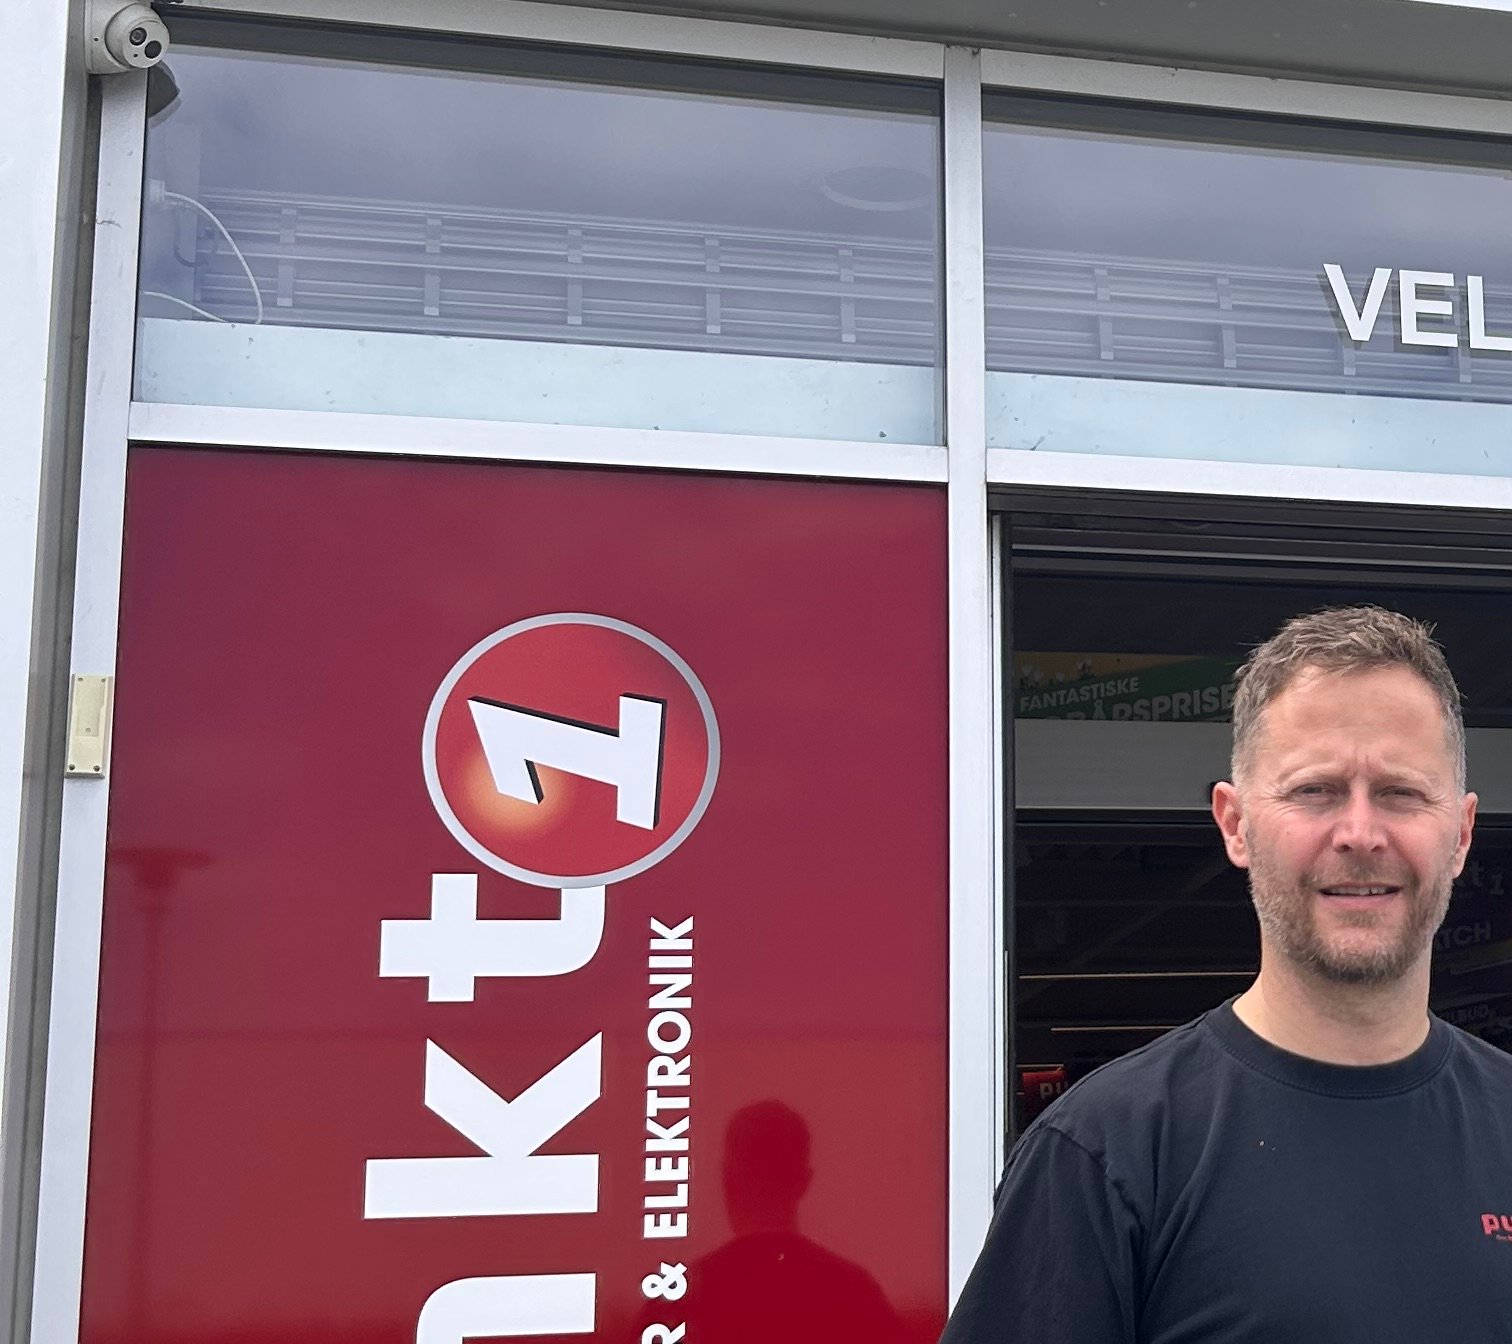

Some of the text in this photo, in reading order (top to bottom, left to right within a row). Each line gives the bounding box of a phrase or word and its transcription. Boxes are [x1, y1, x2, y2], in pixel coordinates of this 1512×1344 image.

[1020, 677, 1139, 712] FANTASTISKE
[643, 916, 694, 1239] ELEKTRONIK
[641, 1262, 688, 1301] &
